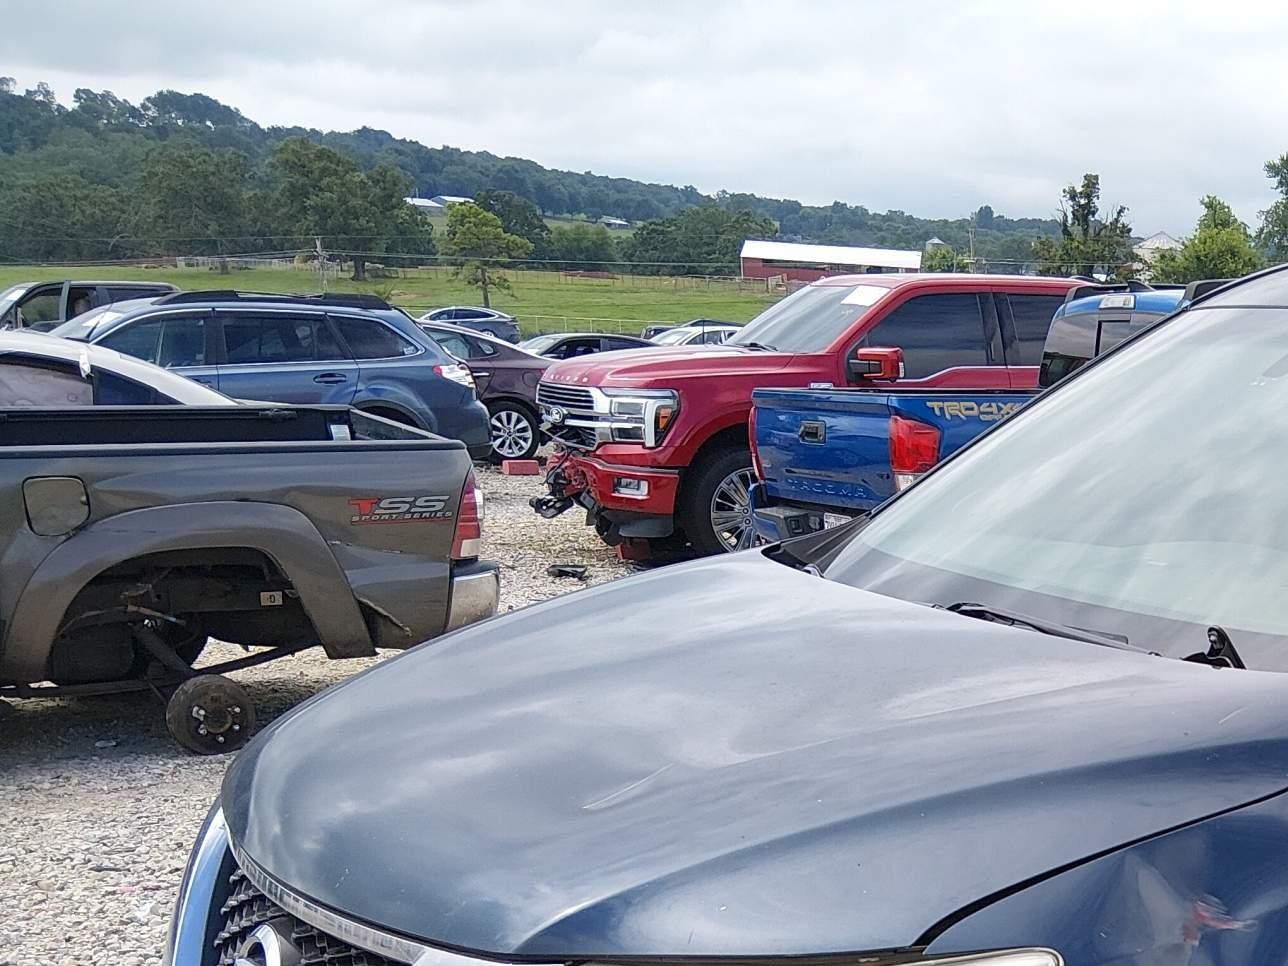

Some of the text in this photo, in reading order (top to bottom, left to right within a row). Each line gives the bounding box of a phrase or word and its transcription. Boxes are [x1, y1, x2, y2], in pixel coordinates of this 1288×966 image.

[349, 495, 450, 515] TSS
[351, 511, 453, 522] SPORT SERIES
